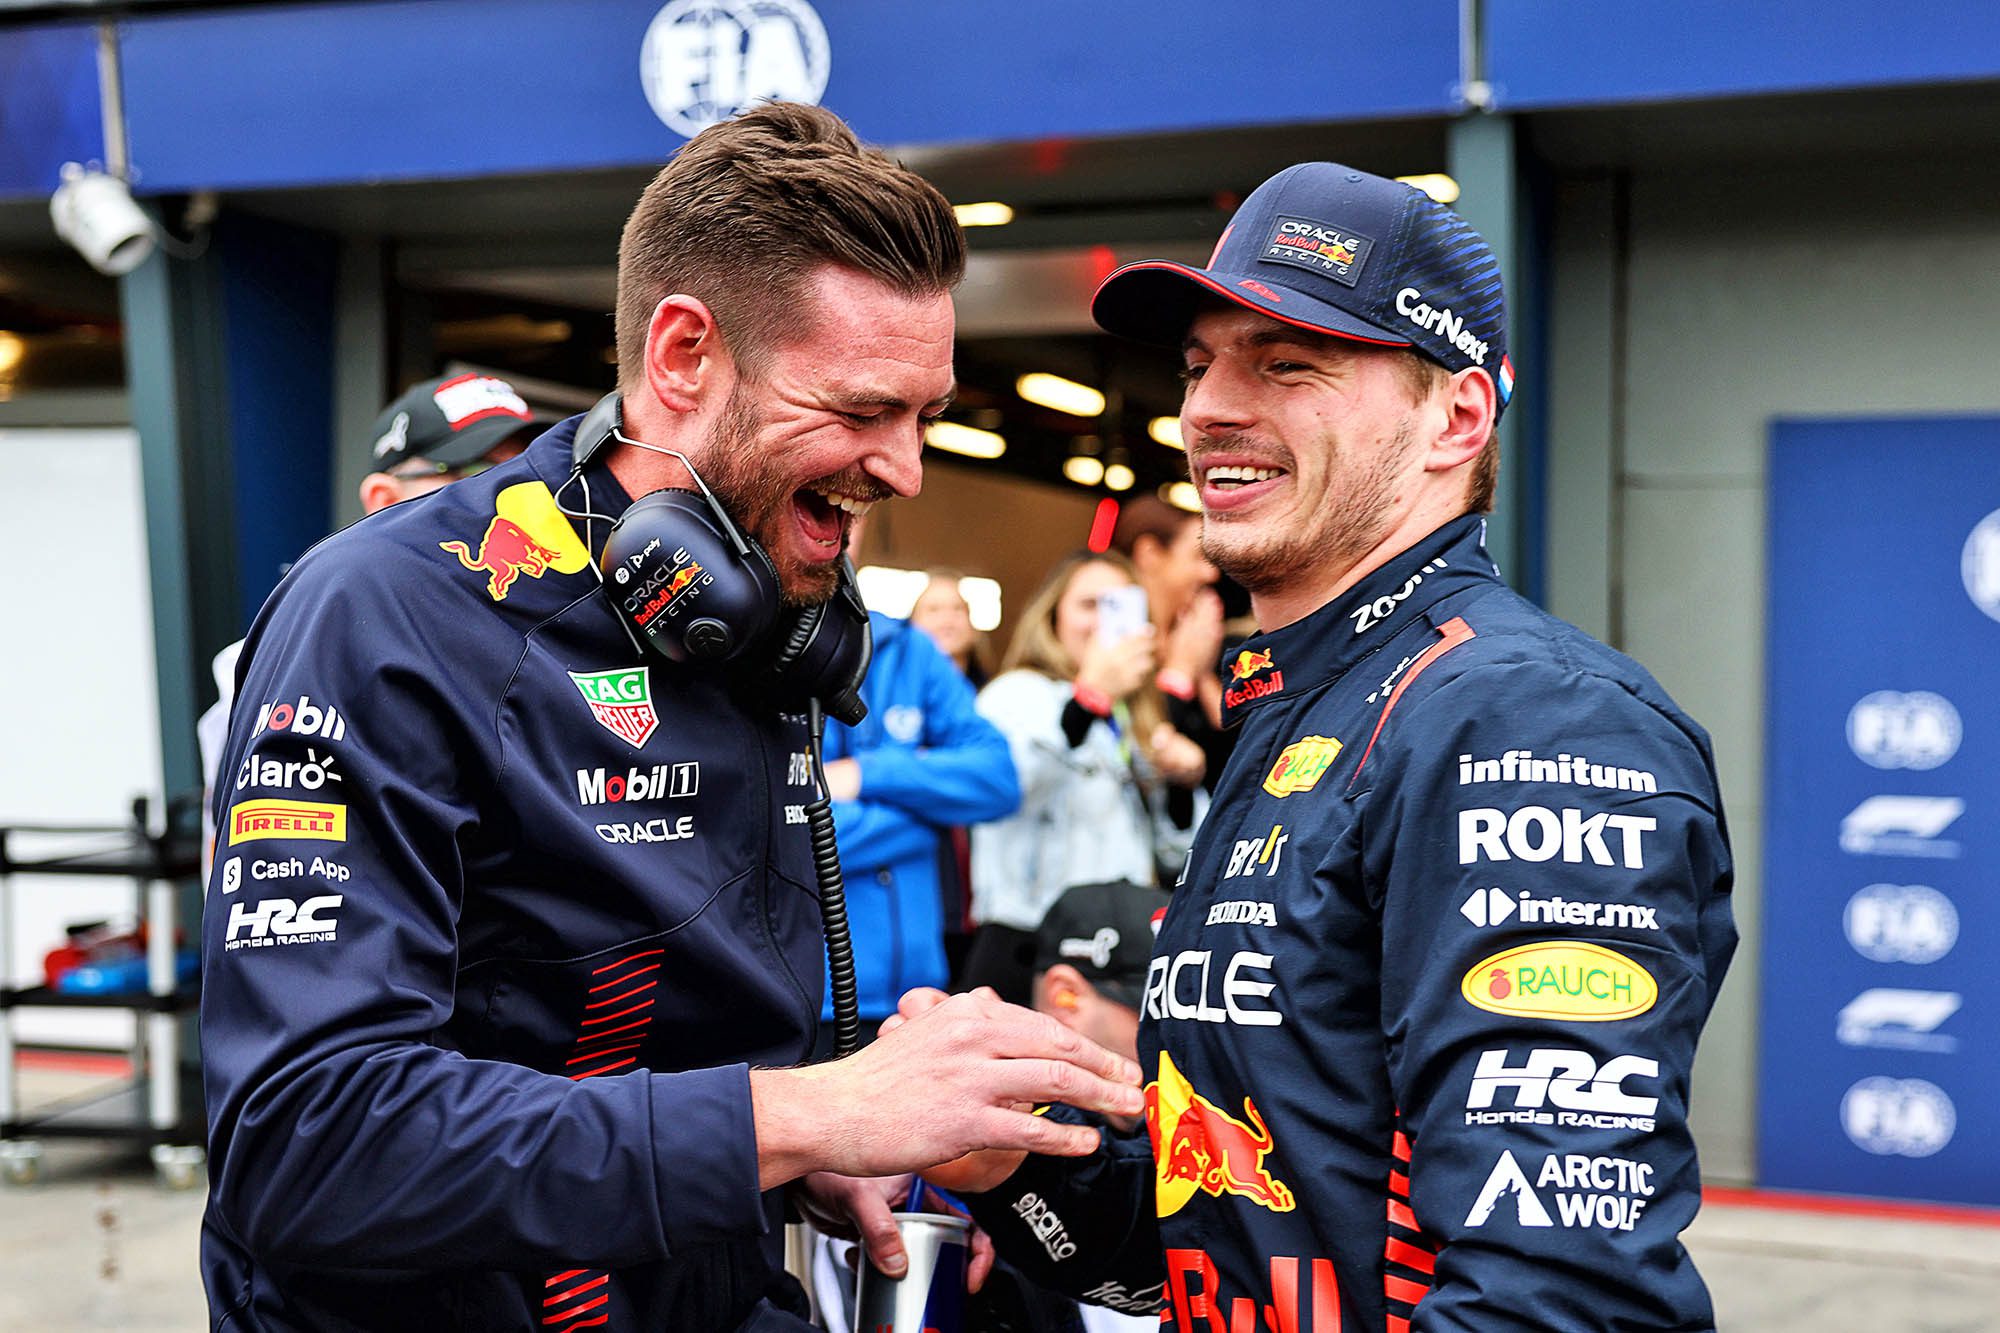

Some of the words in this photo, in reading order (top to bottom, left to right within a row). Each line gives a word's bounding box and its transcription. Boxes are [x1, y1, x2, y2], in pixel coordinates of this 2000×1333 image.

[657, 18, 815, 114] FIA
[1281, 221, 1360, 252] ORACLE
[1268, 247, 1349, 275] RACING
[1396, 287, 1489, 366] CarNext
[624, 547, 691, 612] ORACLE
[647, 575, 714, 637] RACING
[578, 674, 643, 701] TAG
[592, 703, 653, 741] HEUER
[576, 764, 668, 806] Mobil
[1459, 750, 1658, 793] infinitum
[235, 807, 335, 836] PIRELLI
[595, 816, 695, 844] ORACLE
[1458, 805, 1657, 869] ROKT
[251, 861, 304, 880] Cash
[309, 857, 350, 882] App
[225, 895, 343, 941] HRC
[1518, 890, 1660, 930] inter.mx
[225, 937, 274, 952] Honda
[276, 931, 336, 946] RACING
[1518, 965, 1632, 1004] RAUCH
[1466, 1049, 1659, 1116] HRC
[1465, 1109, 1554, 1126] Honda
[1557, 1112, 1656, 1133] RACING
[1536, 1154, 1656, 1197] ARCTIC
[1555, 1193, 1647, 1231] WOLF
